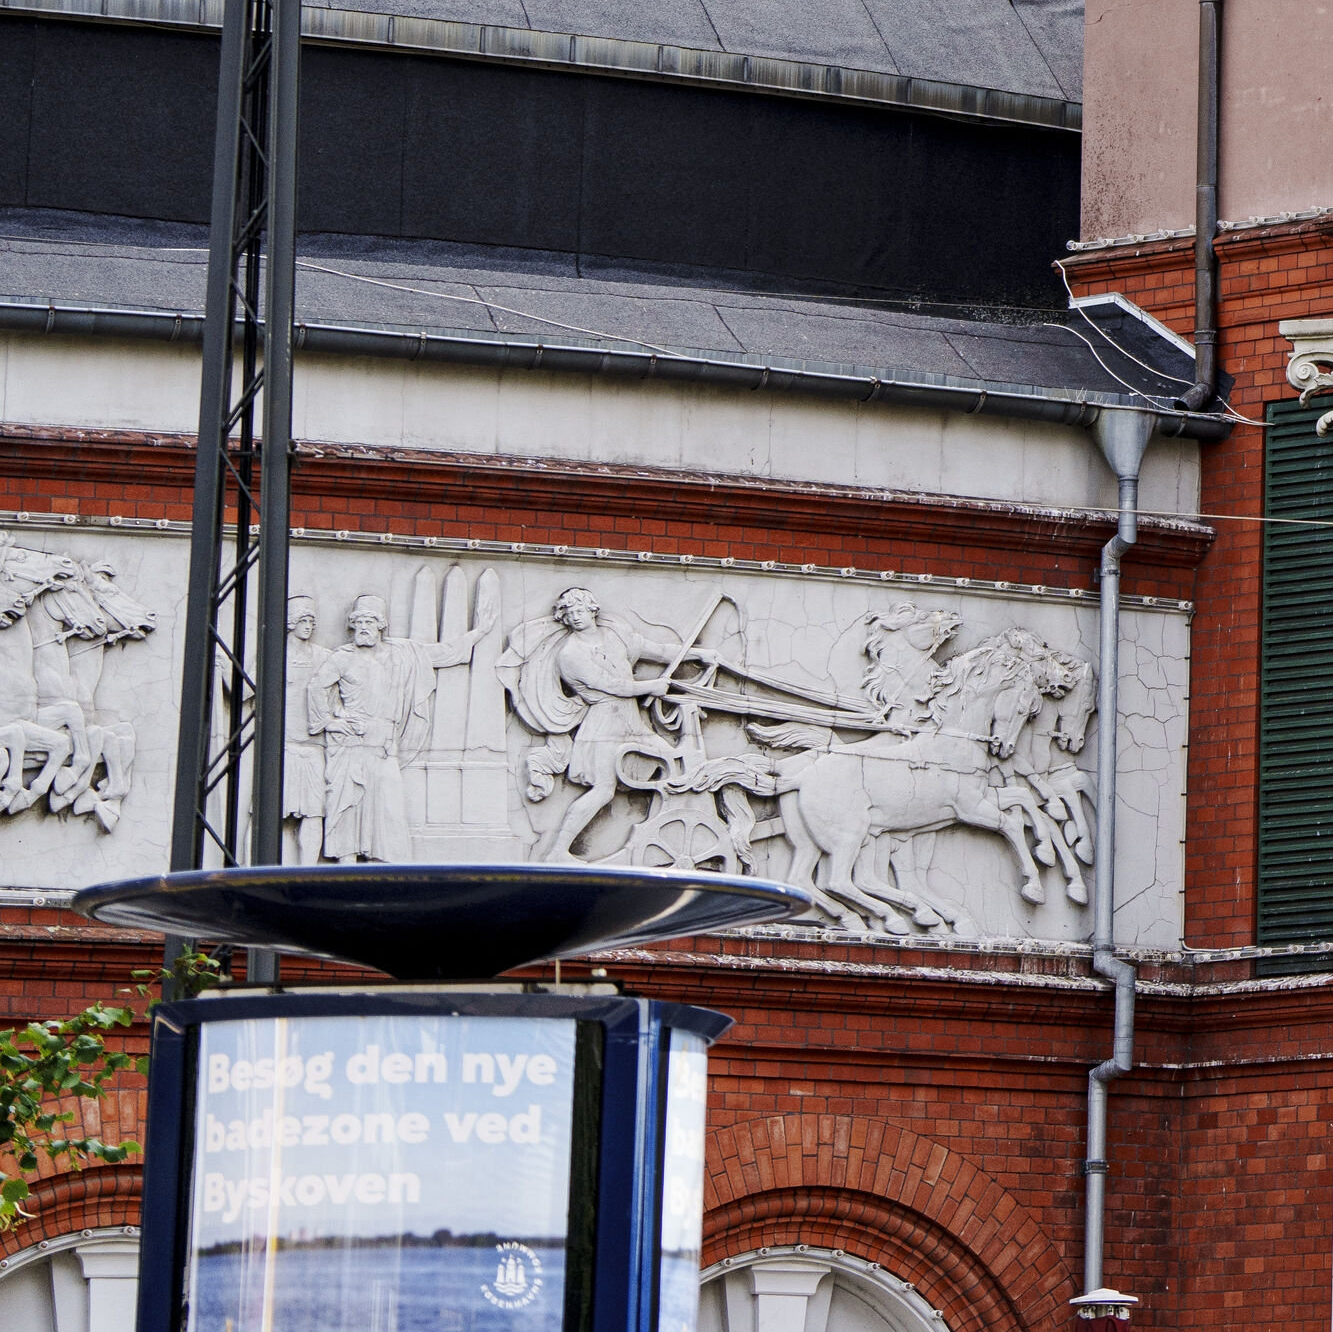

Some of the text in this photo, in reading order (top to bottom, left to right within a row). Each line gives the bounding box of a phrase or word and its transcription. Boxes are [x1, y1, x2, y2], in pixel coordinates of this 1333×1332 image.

[208, 1044, 558, 1100] Besøg den nye
[205, 1104, 542, 1153] badezone ved
[203, 1172, 421, 1224] Byskoven
